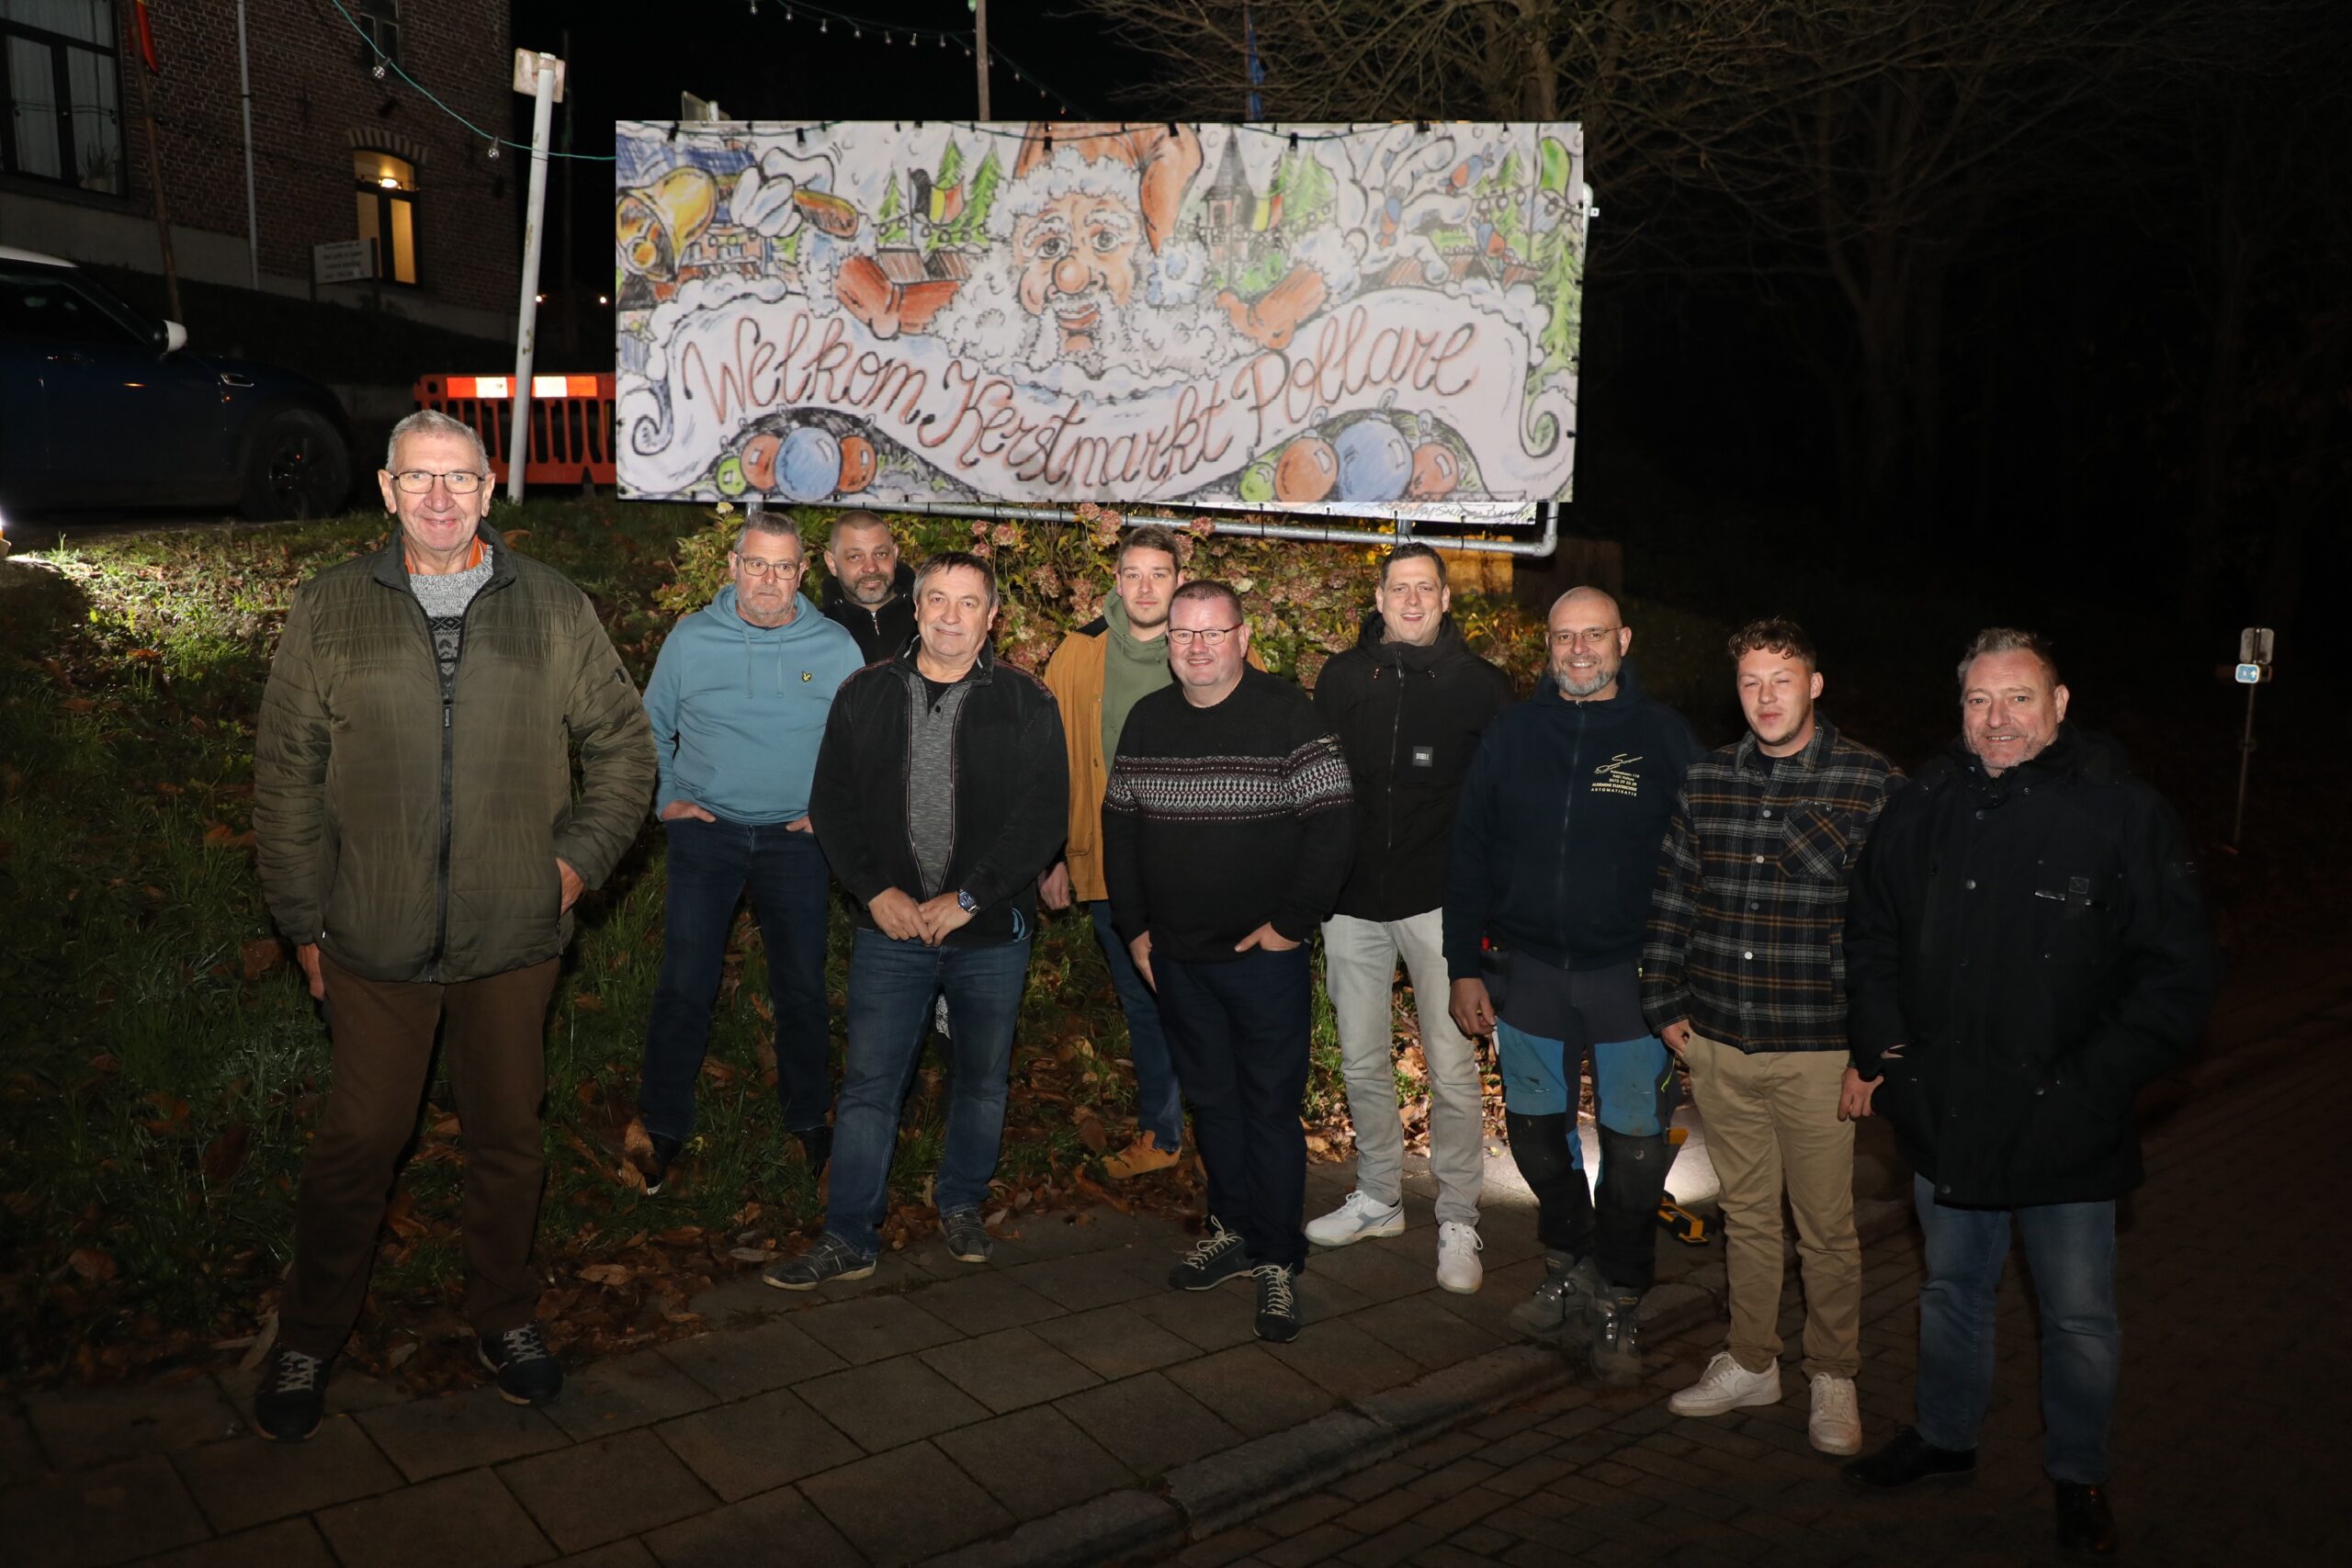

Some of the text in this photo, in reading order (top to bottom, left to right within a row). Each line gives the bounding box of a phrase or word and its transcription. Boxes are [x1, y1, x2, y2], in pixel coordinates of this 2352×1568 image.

[683, 305, 1476, 488] Welkom Kerstmarkt Pollare
